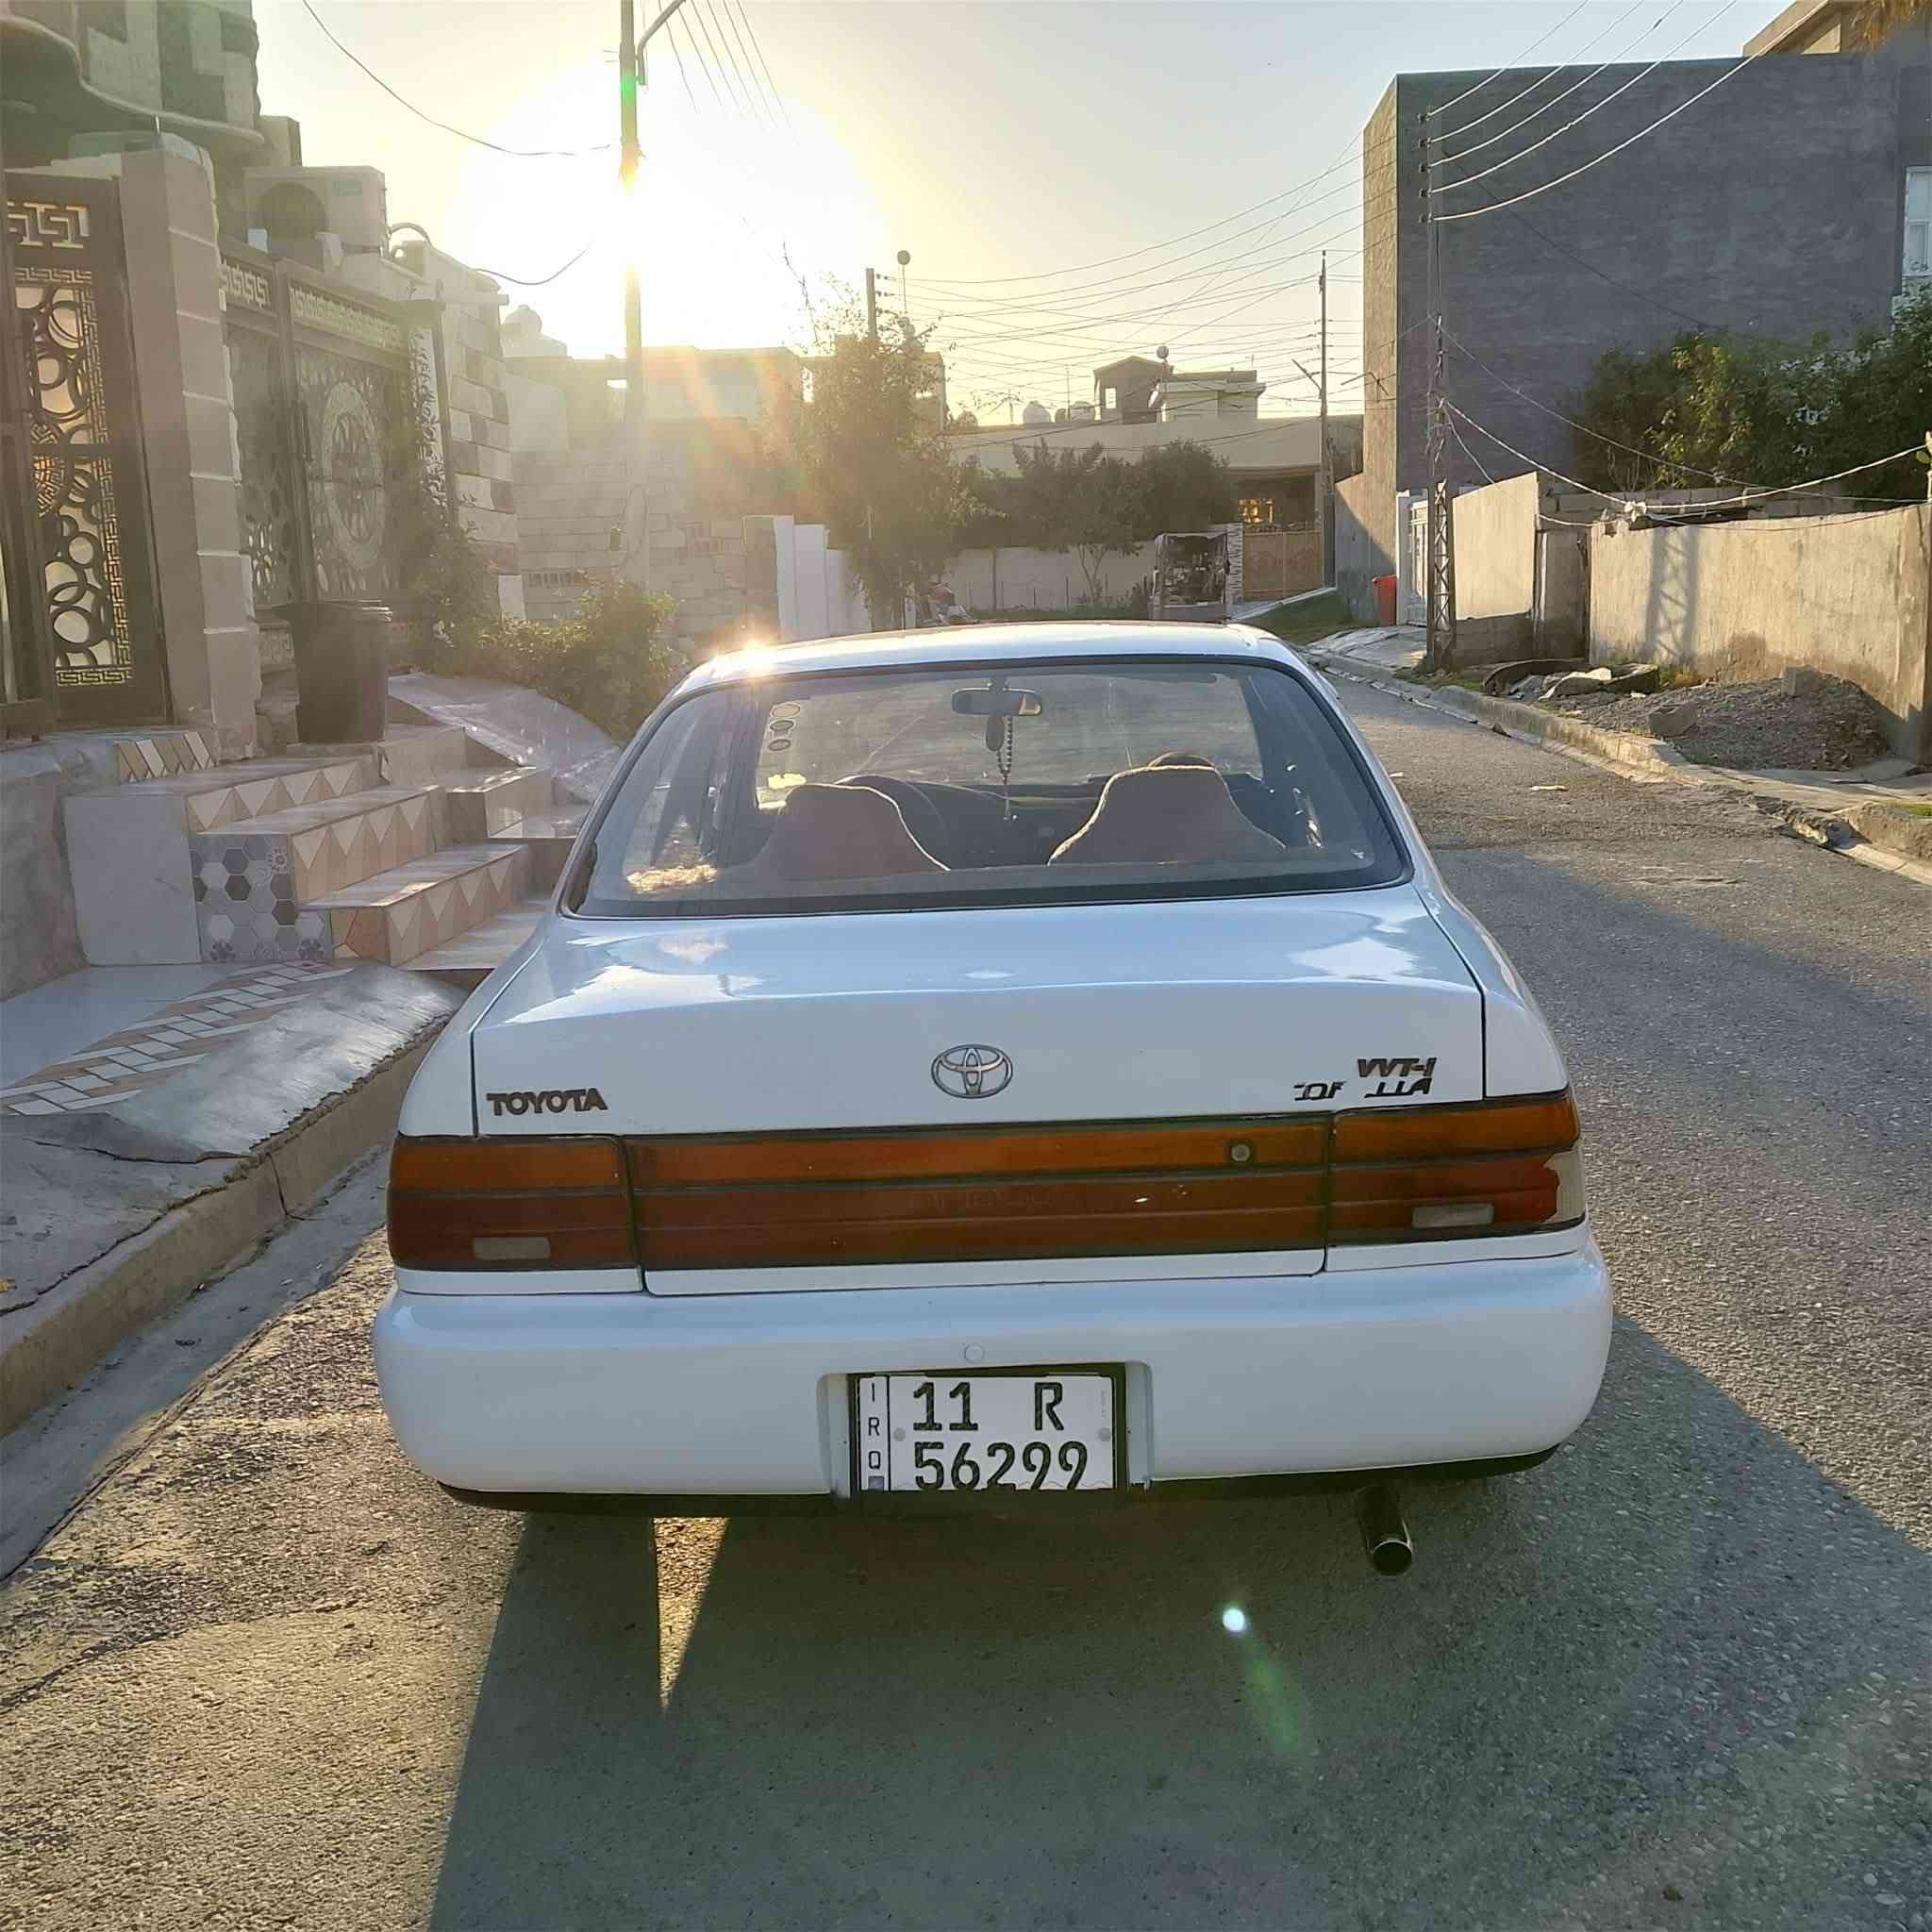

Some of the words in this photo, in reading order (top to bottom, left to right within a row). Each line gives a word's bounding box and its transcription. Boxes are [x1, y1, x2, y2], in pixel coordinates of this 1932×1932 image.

[486, 1088, 608, 1116] TOYOTA
[912, 1381, 978, 1431] 11
[1034, 1381, 1064, 1431] R
[913, 1441, 1088, 1491] 56299
